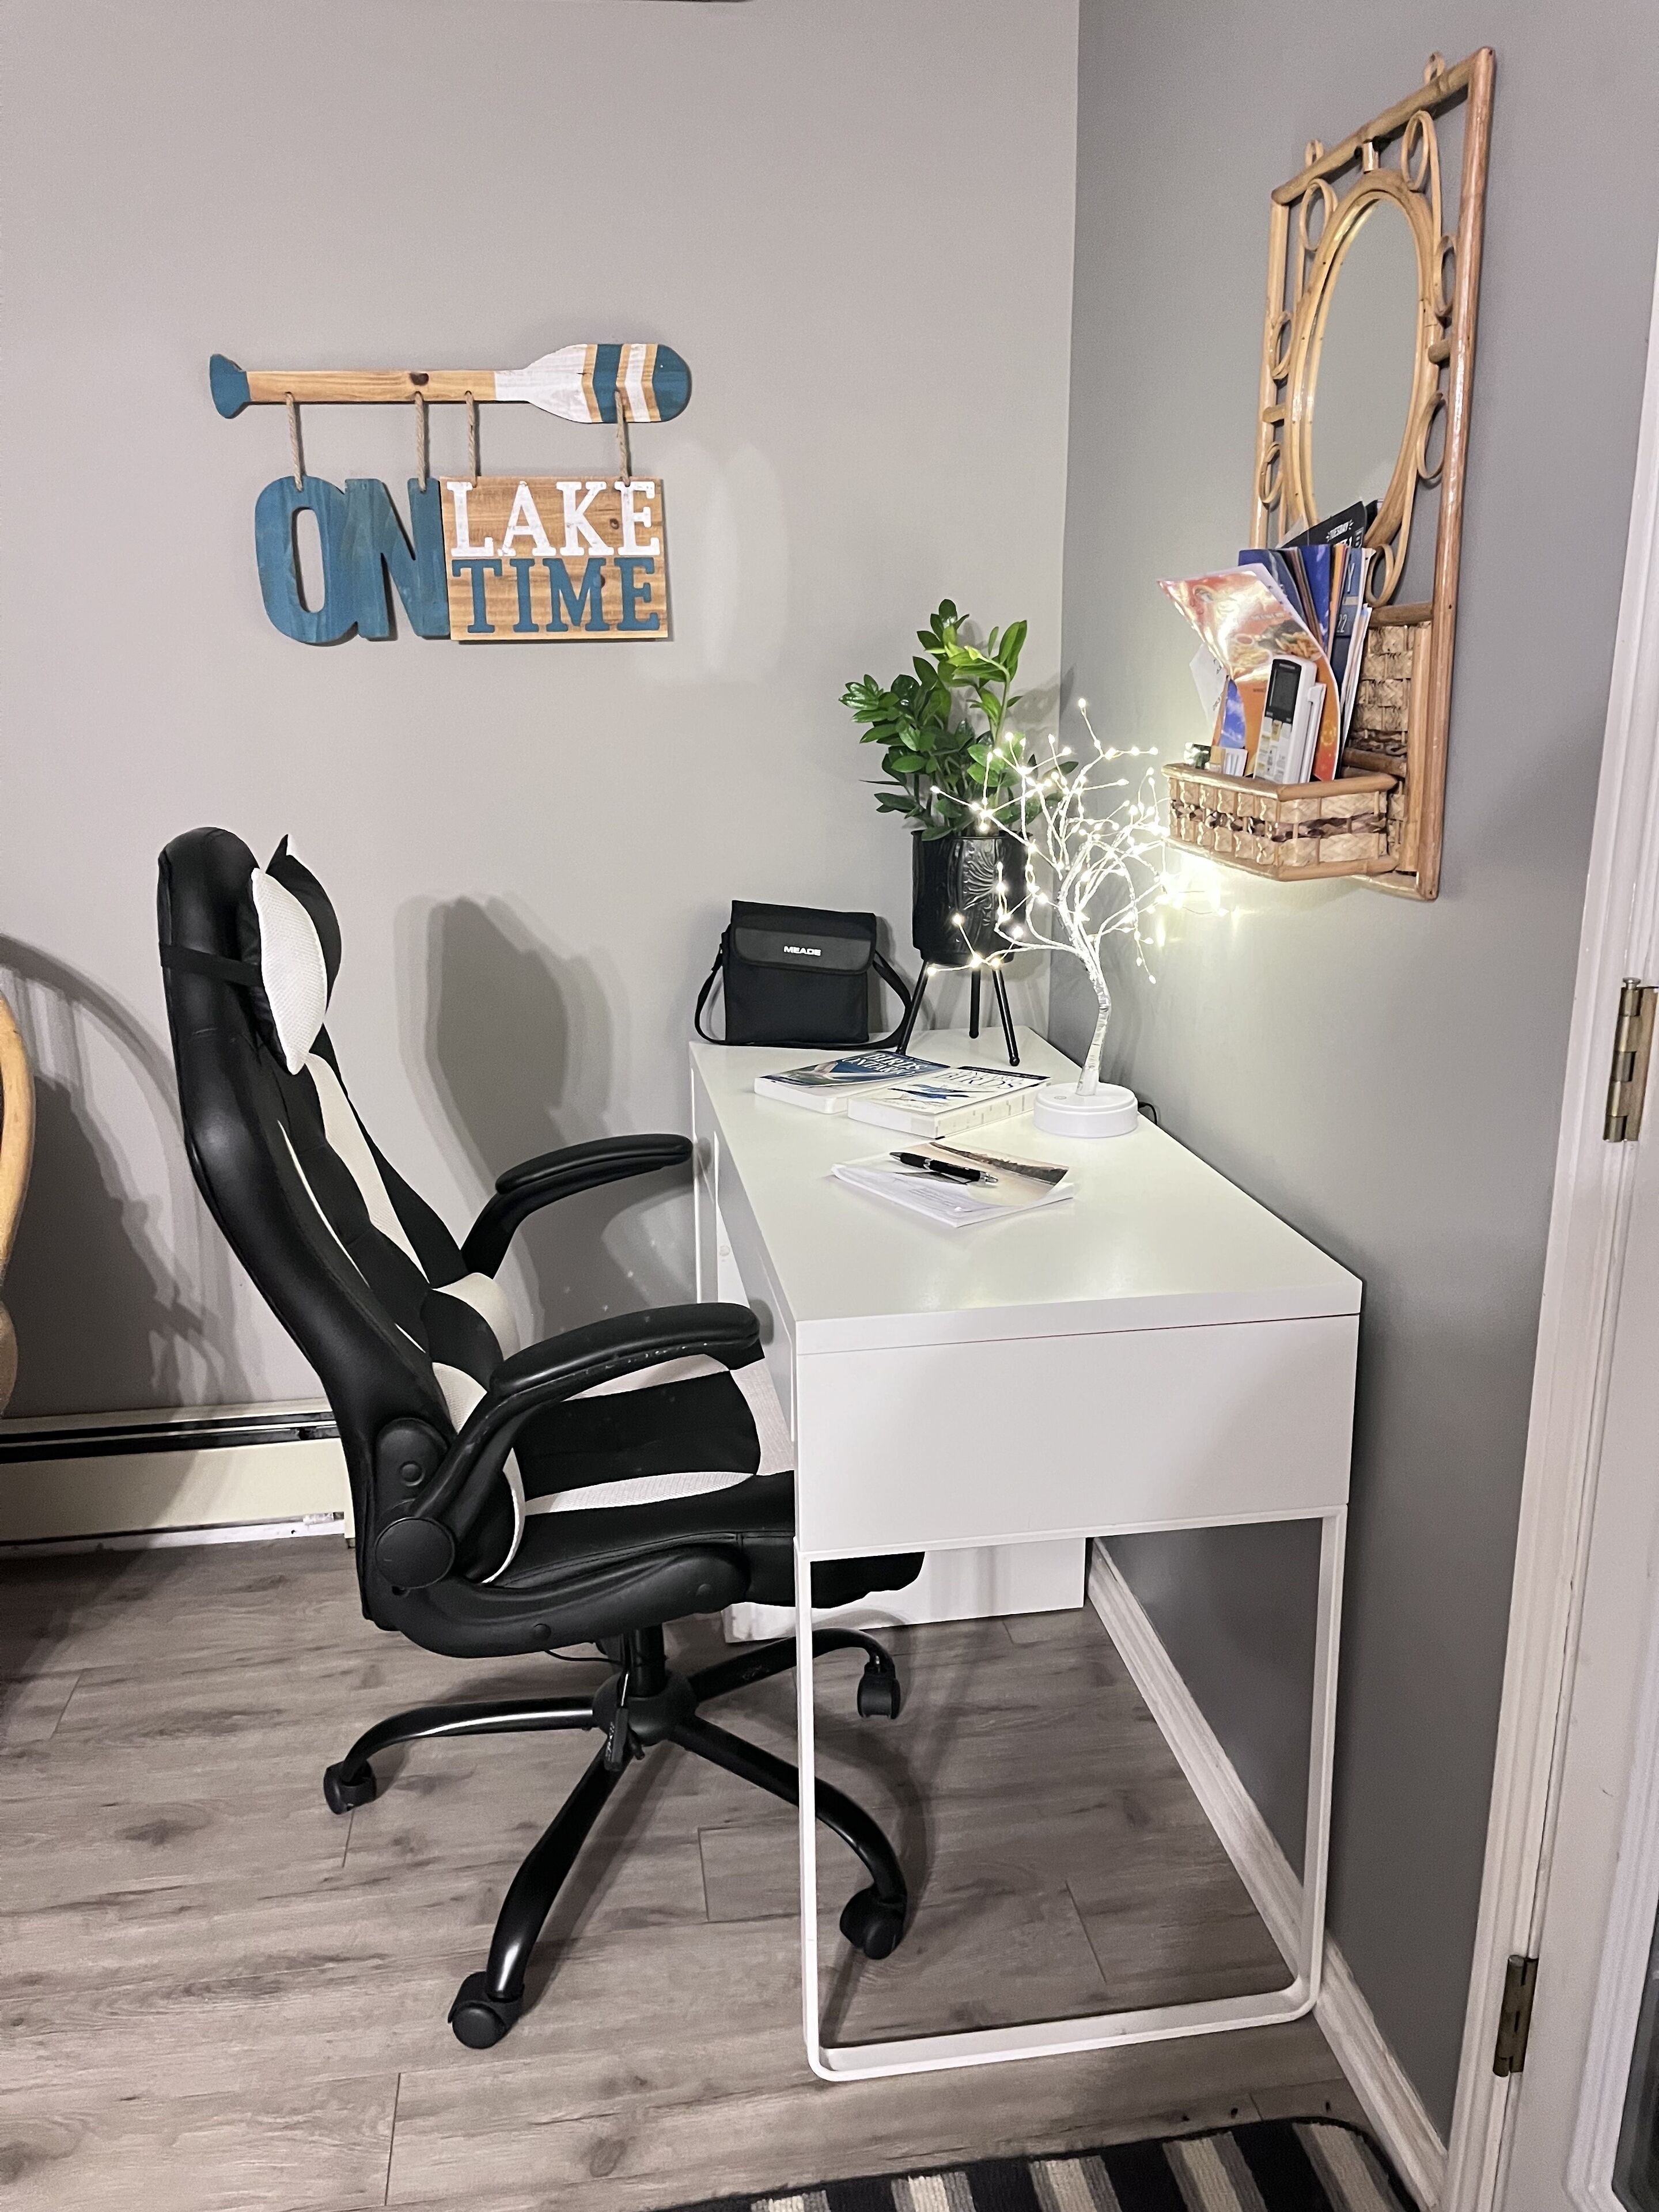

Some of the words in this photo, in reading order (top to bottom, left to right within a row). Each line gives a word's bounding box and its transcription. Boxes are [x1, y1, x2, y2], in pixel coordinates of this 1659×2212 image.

[446, 480, 661, 557] LAKE
[255, 476, 451, 644] ON
[451, 557, 660, 634] TIME
[783, 946, 821, 956] MEADE
[842, 1058, 917, 1075] ONTARIO
[864, 1054, 929, 1070] BIRDS
[933, 1072, 1022, 1089] BIRDS
